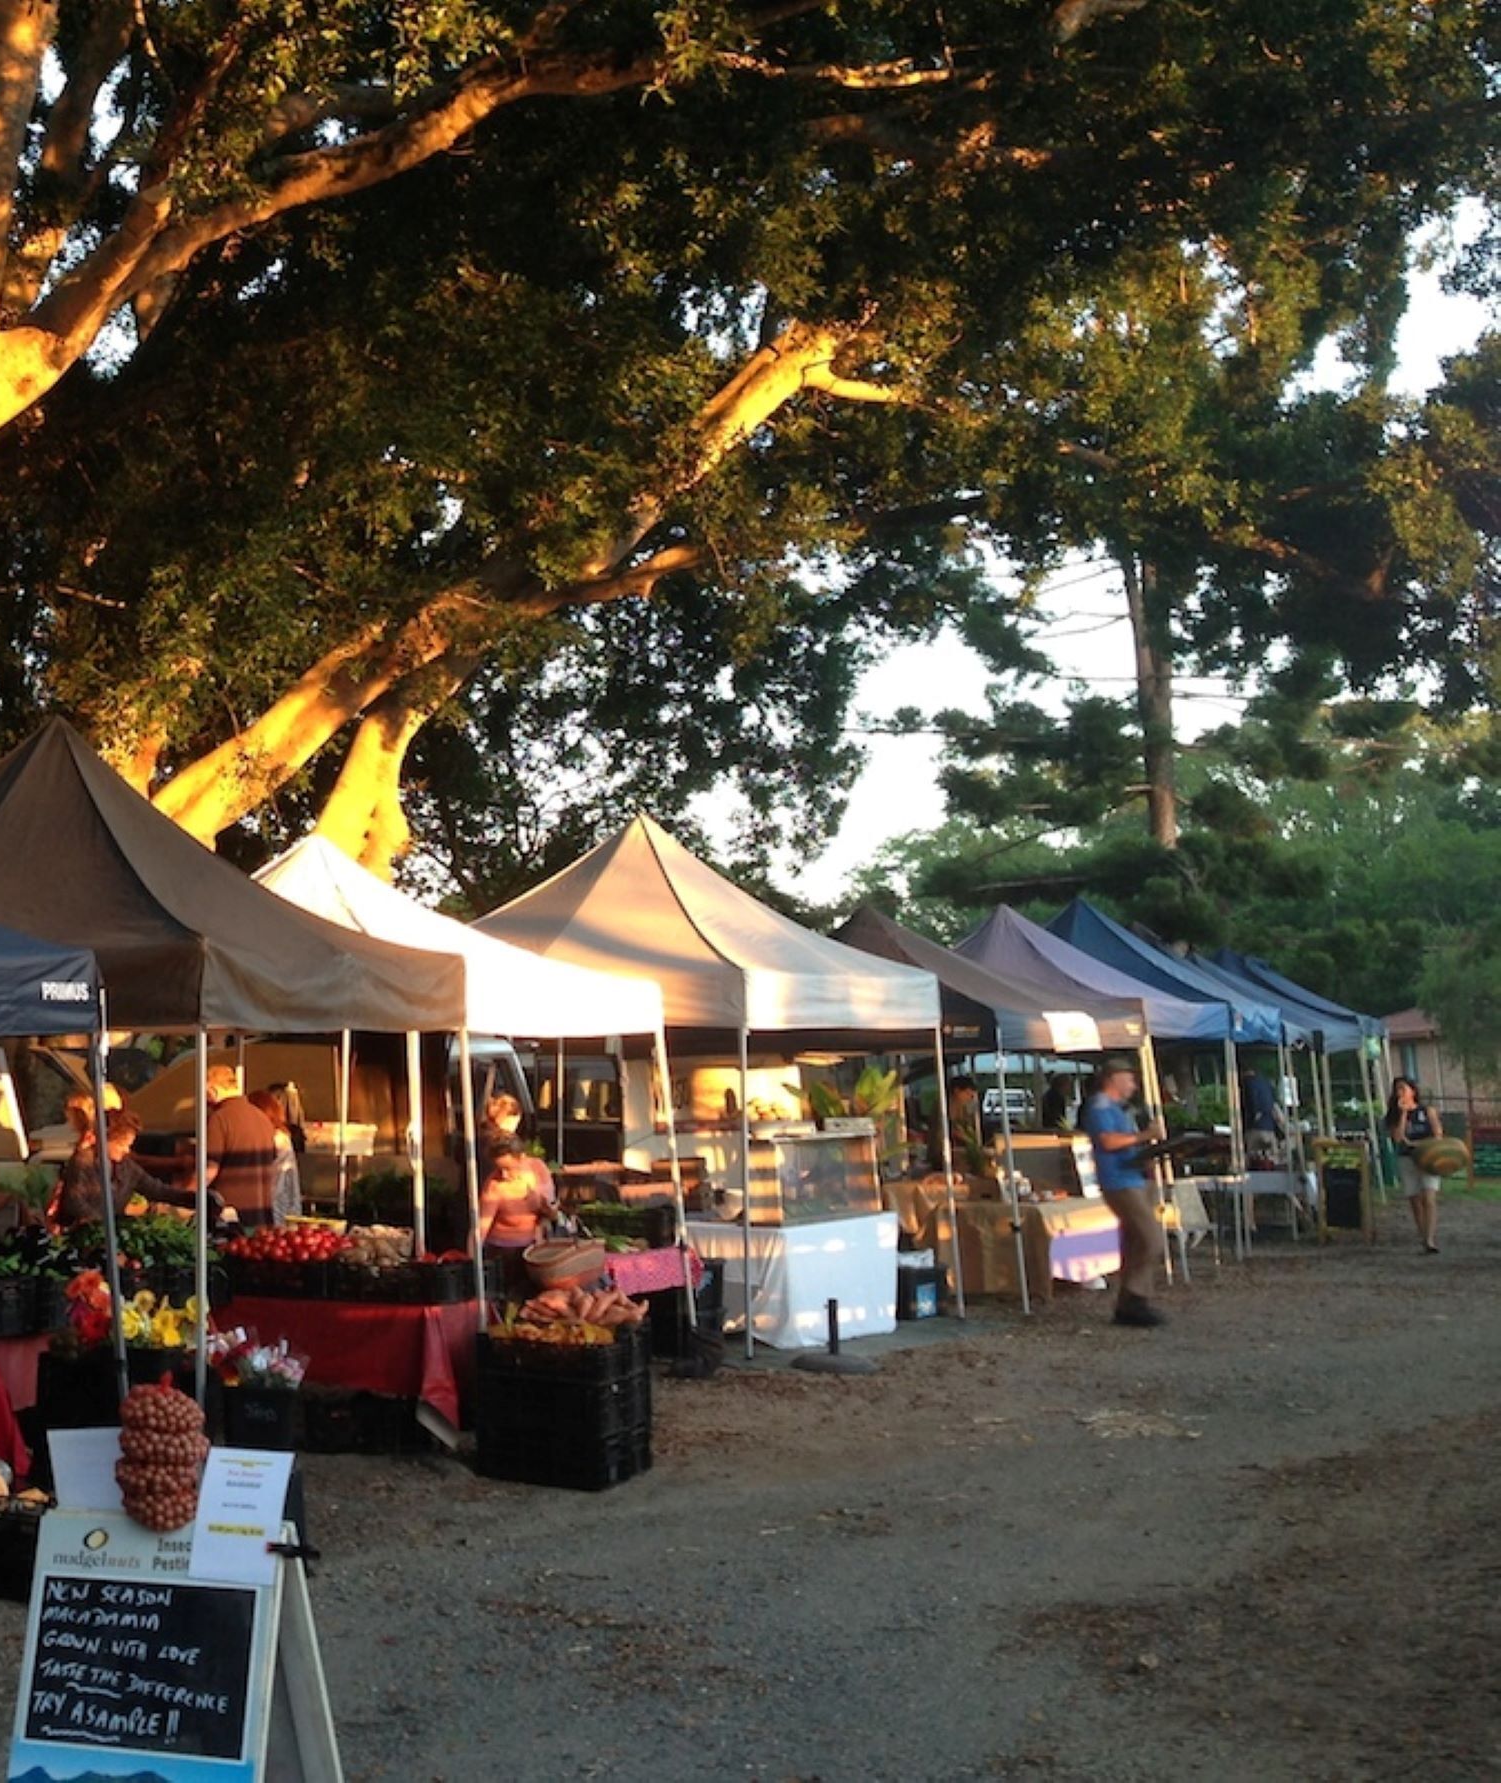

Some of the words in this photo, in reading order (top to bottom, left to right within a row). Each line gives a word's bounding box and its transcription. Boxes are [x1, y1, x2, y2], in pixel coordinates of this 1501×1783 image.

[41, 981, 90, 1001] PRIMUS
[46, 1582, 90, 1602] NEW
[101, 1585, 173, 1607] SEASON
[41, 1605, 160, 1631] MACADAMIA
[42, 1630, 102, 1655] GROWN
[112, 1639, 147, 1661] WITH
[157, 1645, 200, 1666] LOVE
[40, 1657, 85, 1681] TASTE
[90, 1667, 122, 1686] THE
[125, 1673, 229, 1714] DIFFERENCE
[32, 1690, 67, 1715] TRY
